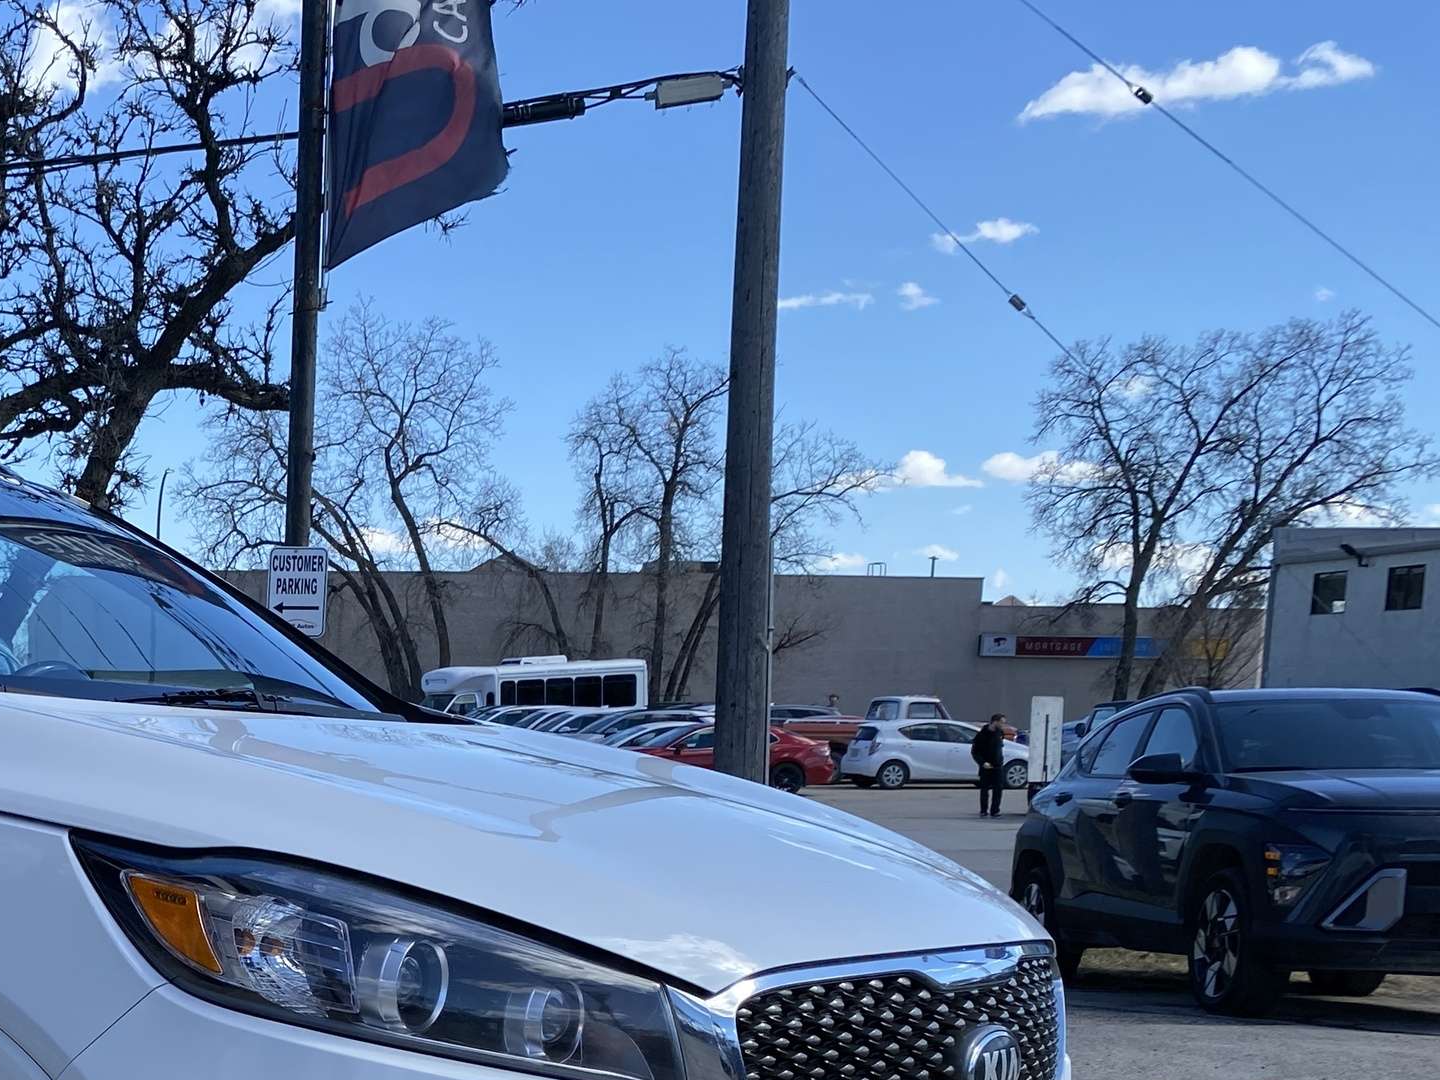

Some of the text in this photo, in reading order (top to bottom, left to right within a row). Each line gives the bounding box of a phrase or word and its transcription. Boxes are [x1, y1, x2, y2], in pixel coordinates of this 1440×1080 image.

[272, 555, 324, 572] CUSTOMER
[276, 578, 318, 595] PARKING
[1024, 641, 1082, 652] MORTGAGE
